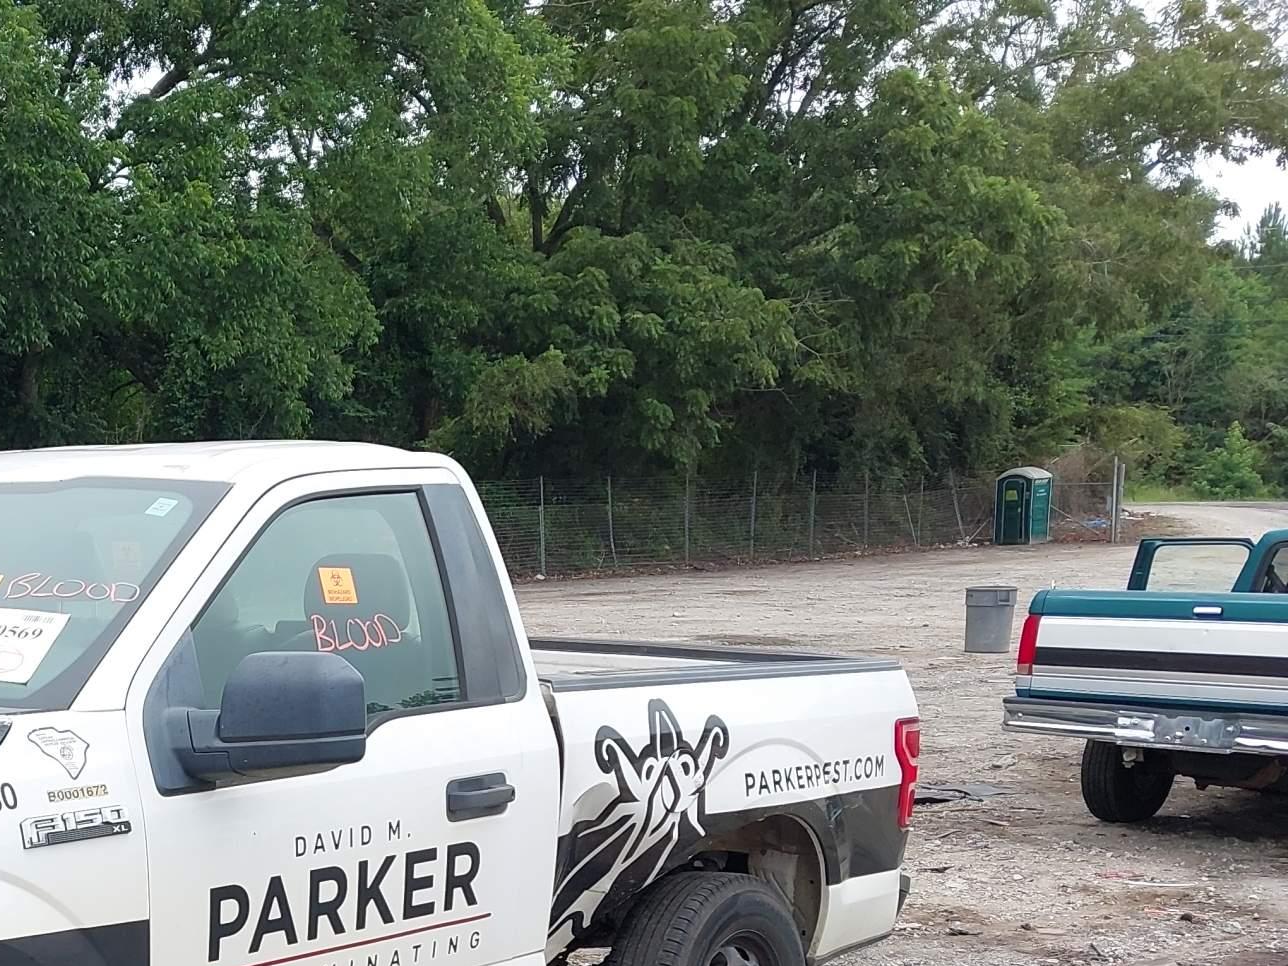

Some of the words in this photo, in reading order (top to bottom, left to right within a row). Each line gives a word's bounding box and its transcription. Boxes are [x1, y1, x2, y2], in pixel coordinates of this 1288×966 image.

[6, 573, 140, 602] BLOOD
[310, 613, 402, 652] BLOOD
[47, 784, 109, 803] B0001672
[744, 755, 884, 796] PARKERPEST.COM
[112, 824, 129, 834] XL
[294, 824, 373, 858] DAVID
[387, 819, 412, 842] M.
[207, 841, 481, 962] PARKER
